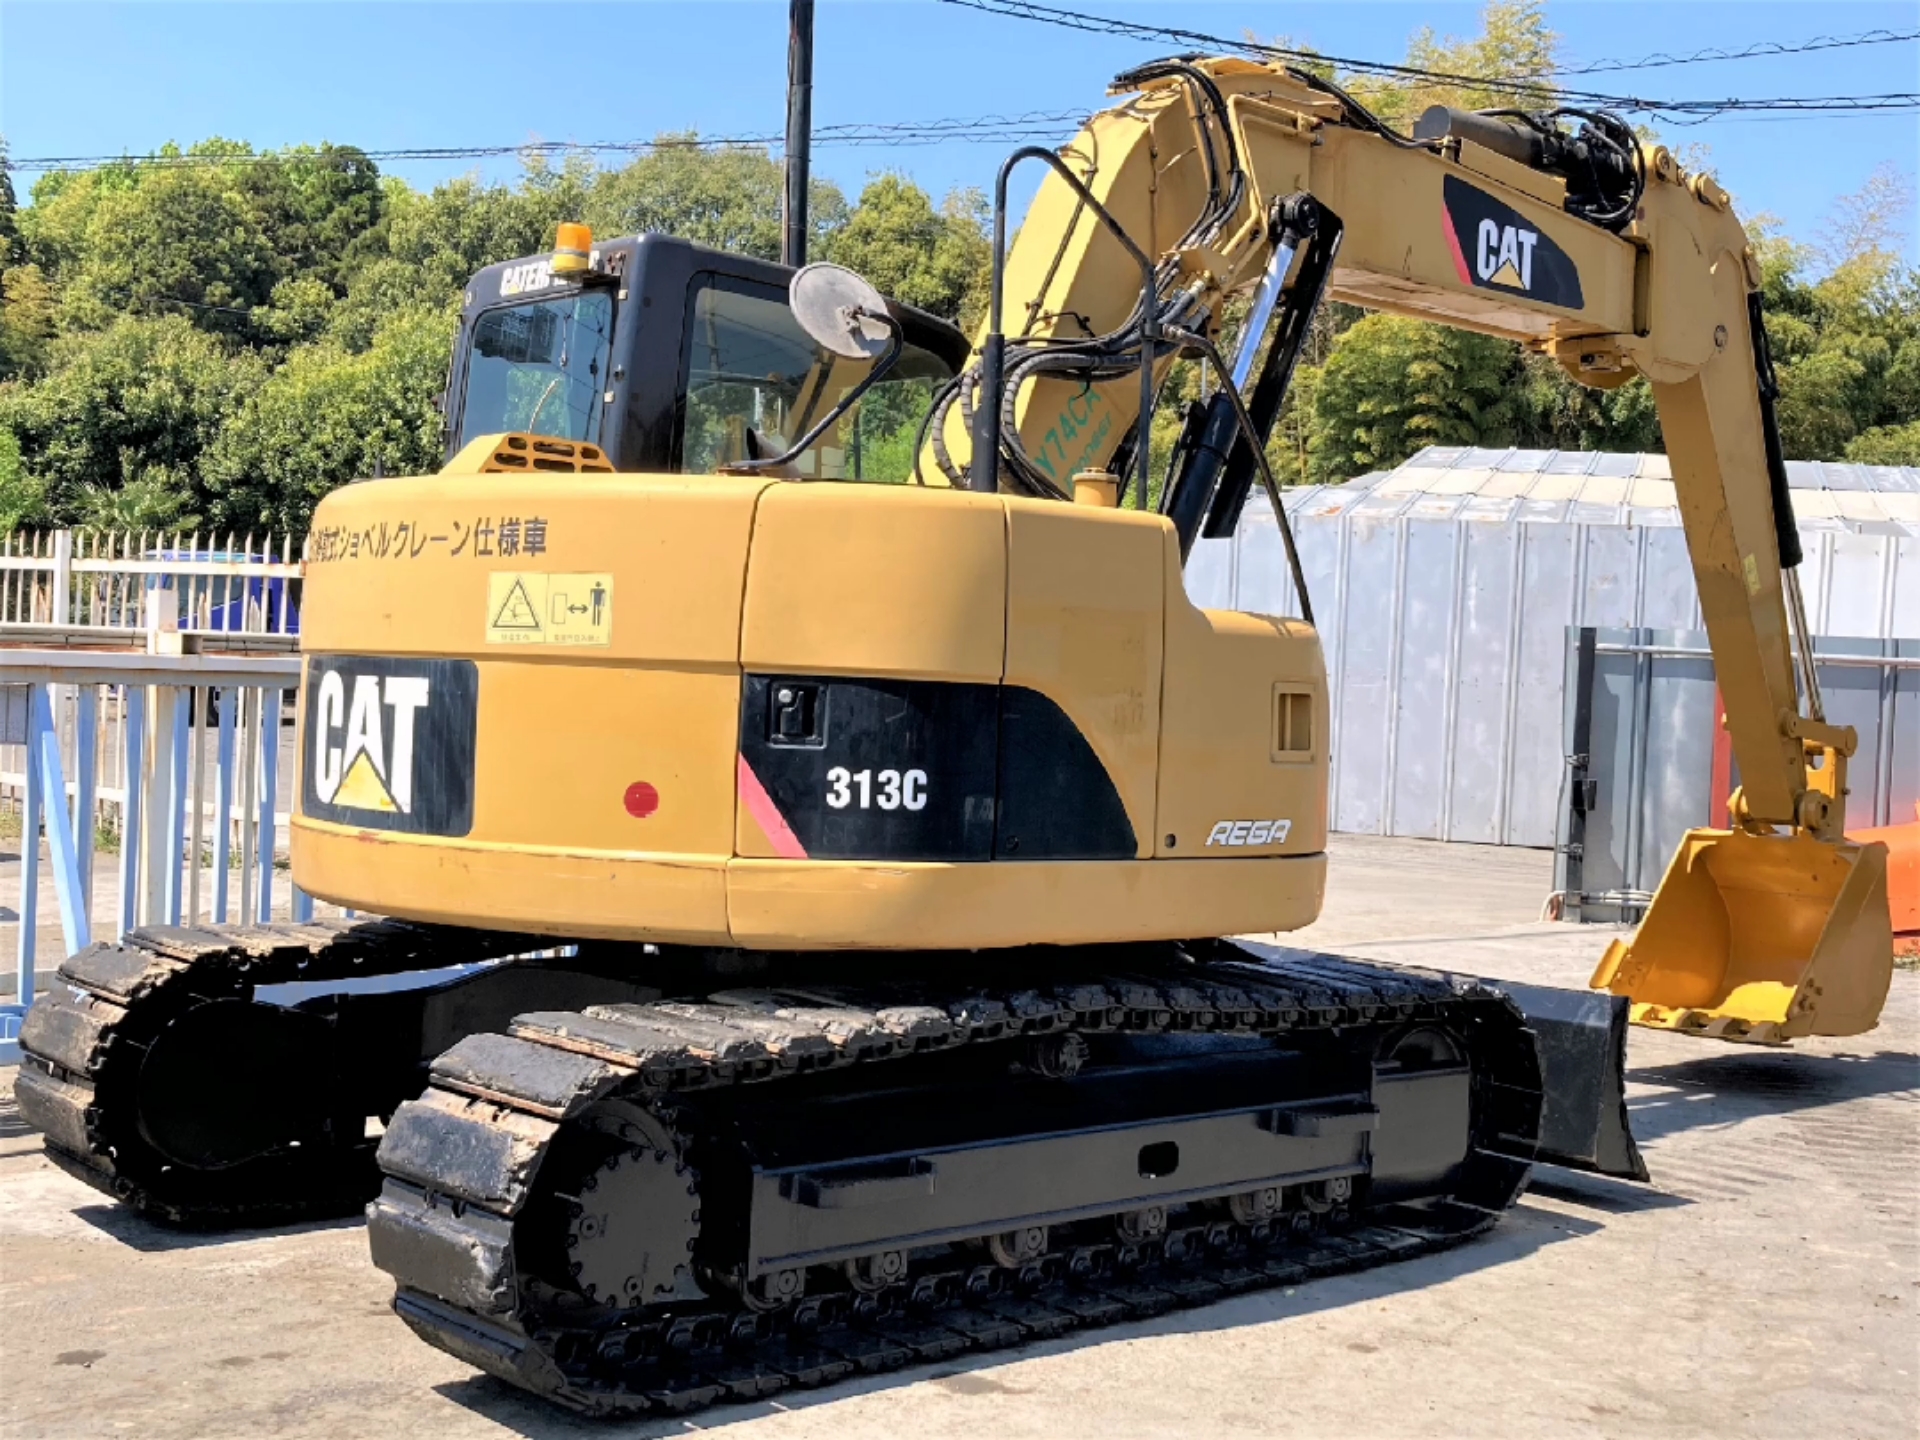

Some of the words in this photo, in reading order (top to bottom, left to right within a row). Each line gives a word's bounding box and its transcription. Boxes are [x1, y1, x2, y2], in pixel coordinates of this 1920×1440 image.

[1477, 218, 1538, 291] CAT
[315, 670, 429, 813] CAT
[826, 766, 928, 811] 313C
[1205, 818, 1292, 847] REGA
